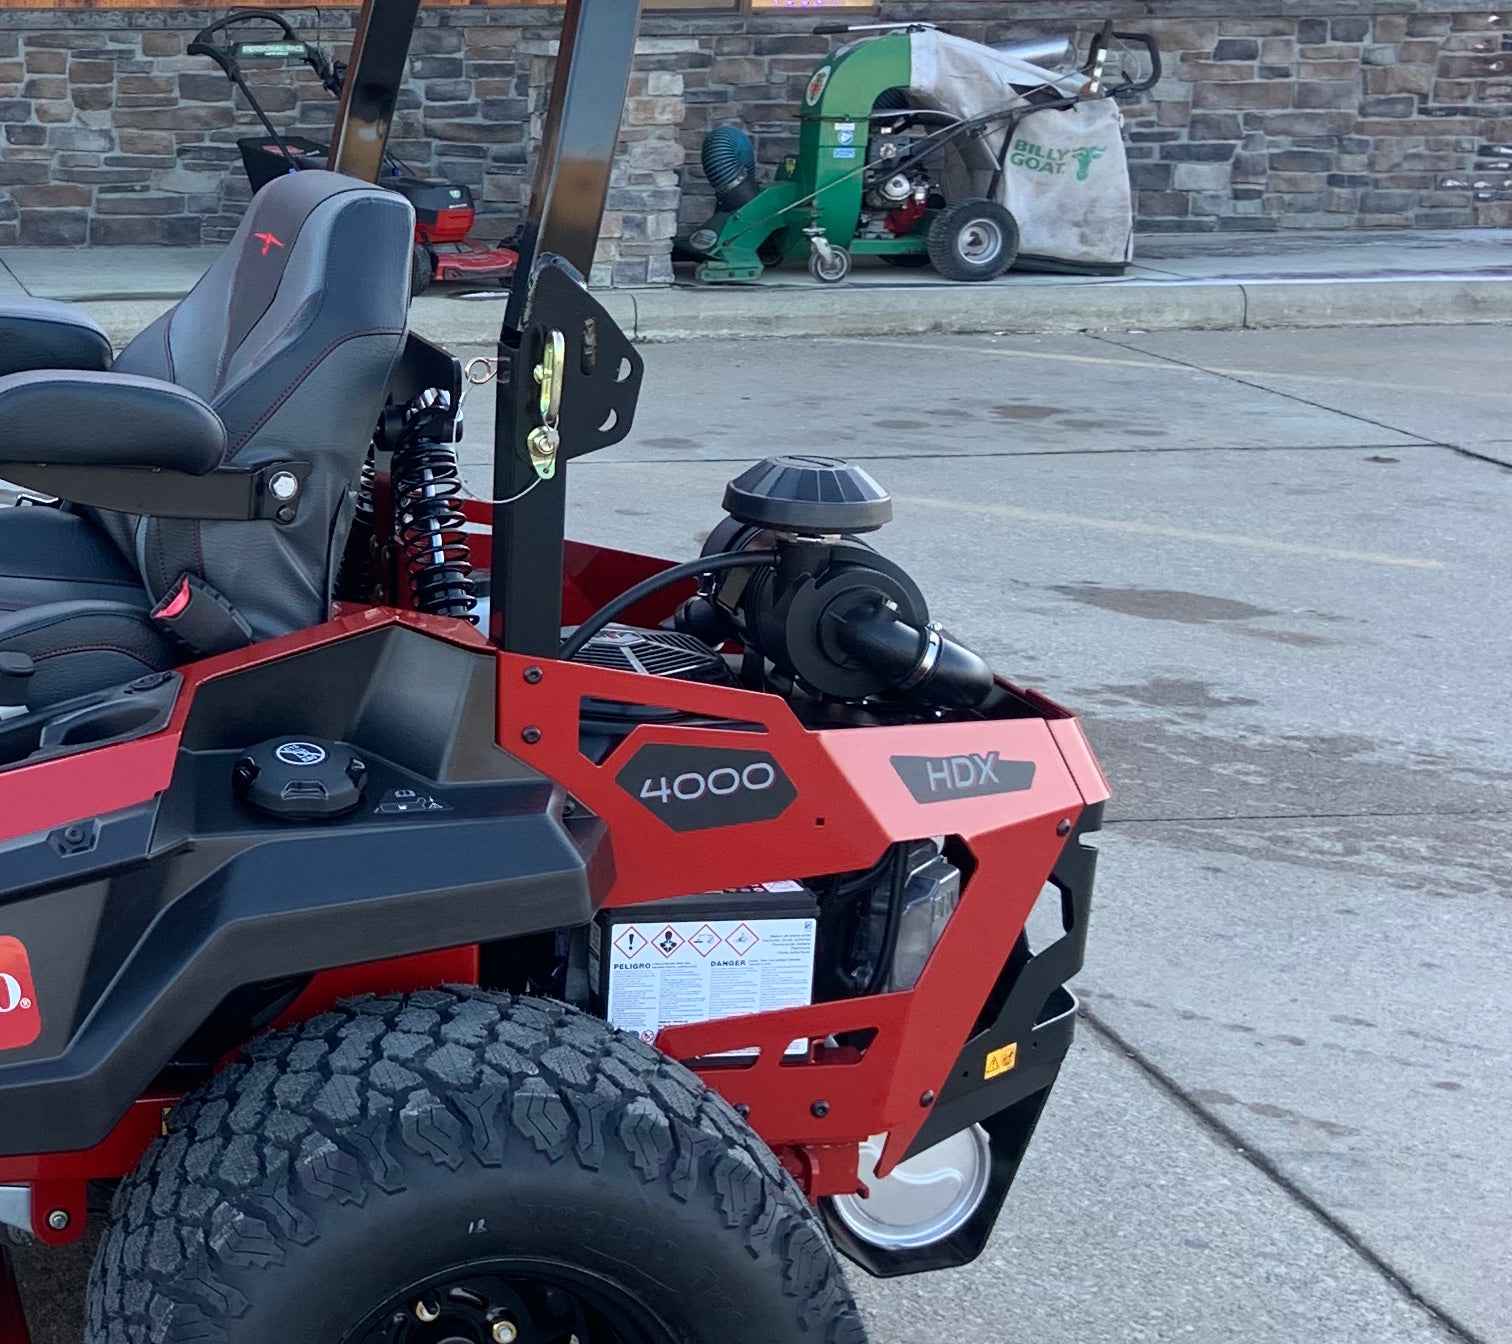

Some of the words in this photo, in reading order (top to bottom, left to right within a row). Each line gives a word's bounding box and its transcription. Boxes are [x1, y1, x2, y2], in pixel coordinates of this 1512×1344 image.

[1014, 139, 1070, 161] BILLY
[639, 762, 775, 803] 4000
[926, 753, 999, 792] HDX
[613, 962, 651, 970] PELIGRO
[710, 959, 746, 967] DANGER
